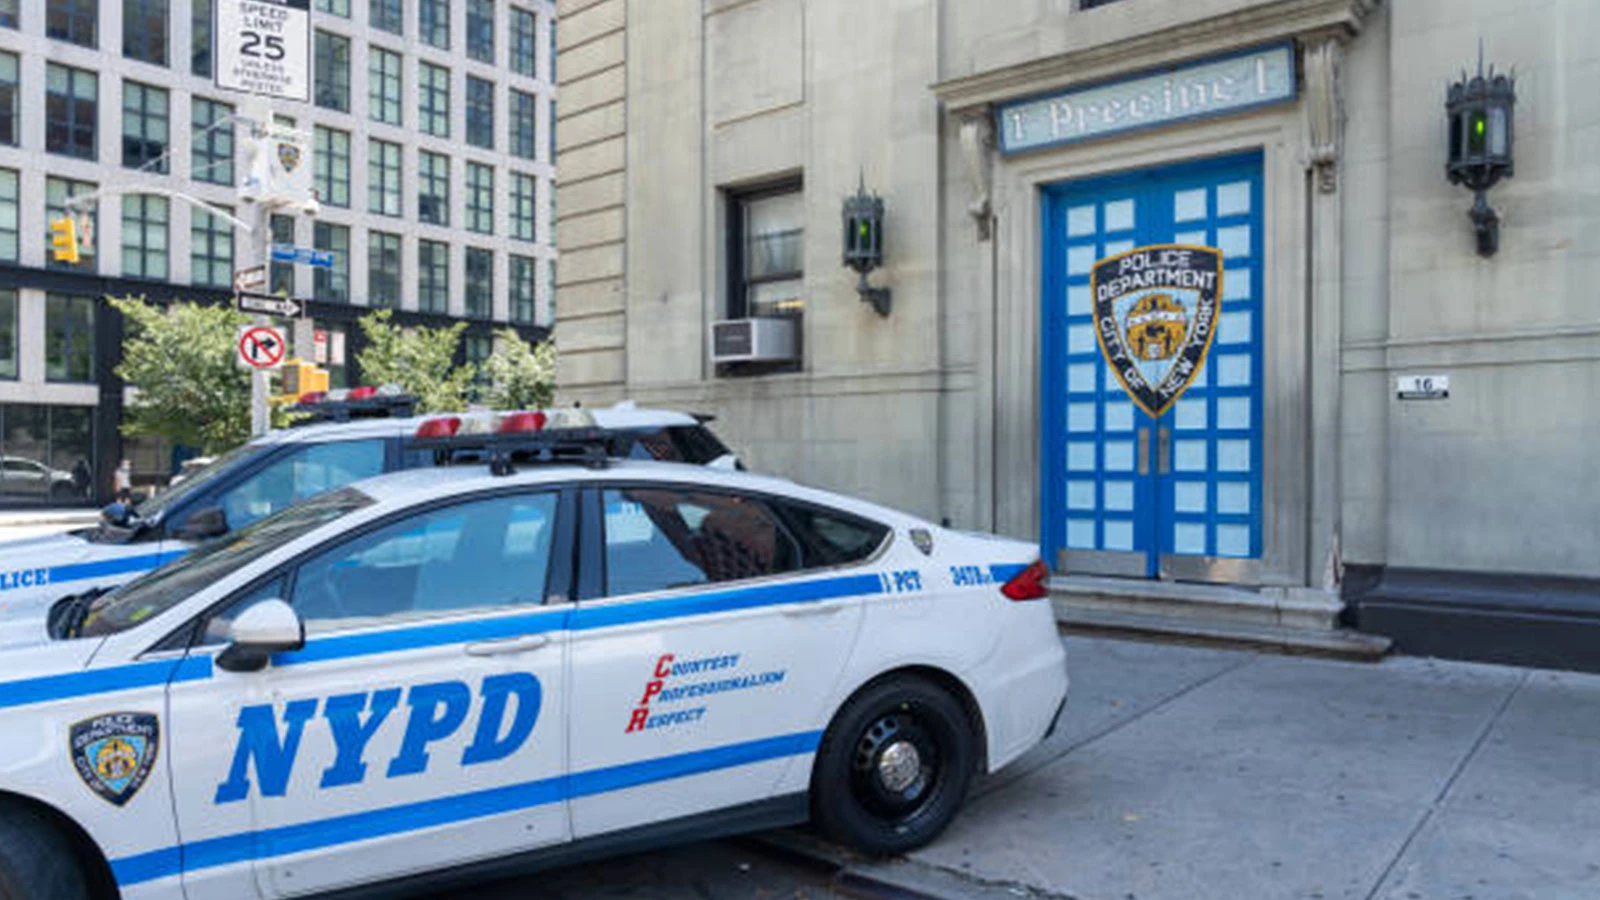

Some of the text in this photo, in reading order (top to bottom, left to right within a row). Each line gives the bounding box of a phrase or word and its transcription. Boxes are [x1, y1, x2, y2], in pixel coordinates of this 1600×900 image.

[239, 2, 288, 20] SPEED
[244, 16, 283, 33] LIMIT
[240, 31, 285, 61] 25
[1117, 250, 1192, 275] POLICE
[1097, 269, 1217, 302] DEPARTMENT
[1100, 317, 1144, 390] CITY OF
[1160, 298, 1213, 398] NEW YORK
[1415, 378, 1433, 393] 16
[892, 569, 922, 592] PCT
[213, 671, 543, 805] NYPD
